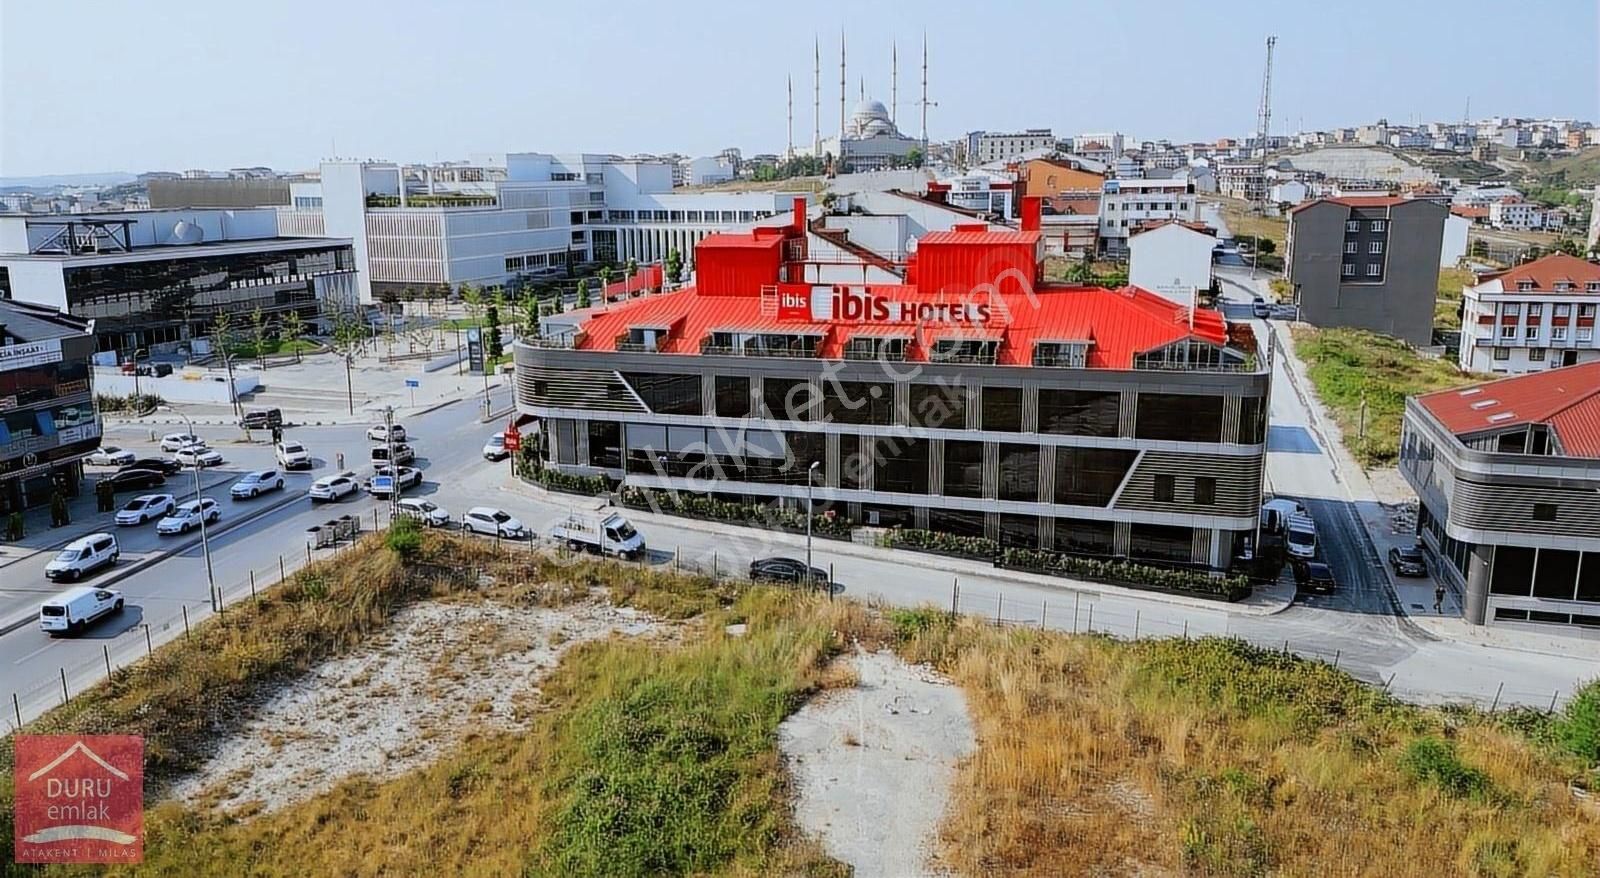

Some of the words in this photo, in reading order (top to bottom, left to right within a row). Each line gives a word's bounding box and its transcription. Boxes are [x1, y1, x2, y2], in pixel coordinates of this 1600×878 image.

[781, 292, 807, 309] ibis
[831, 285, 890, 321] ibis
[900, 301, 991, 323] HOTELS
